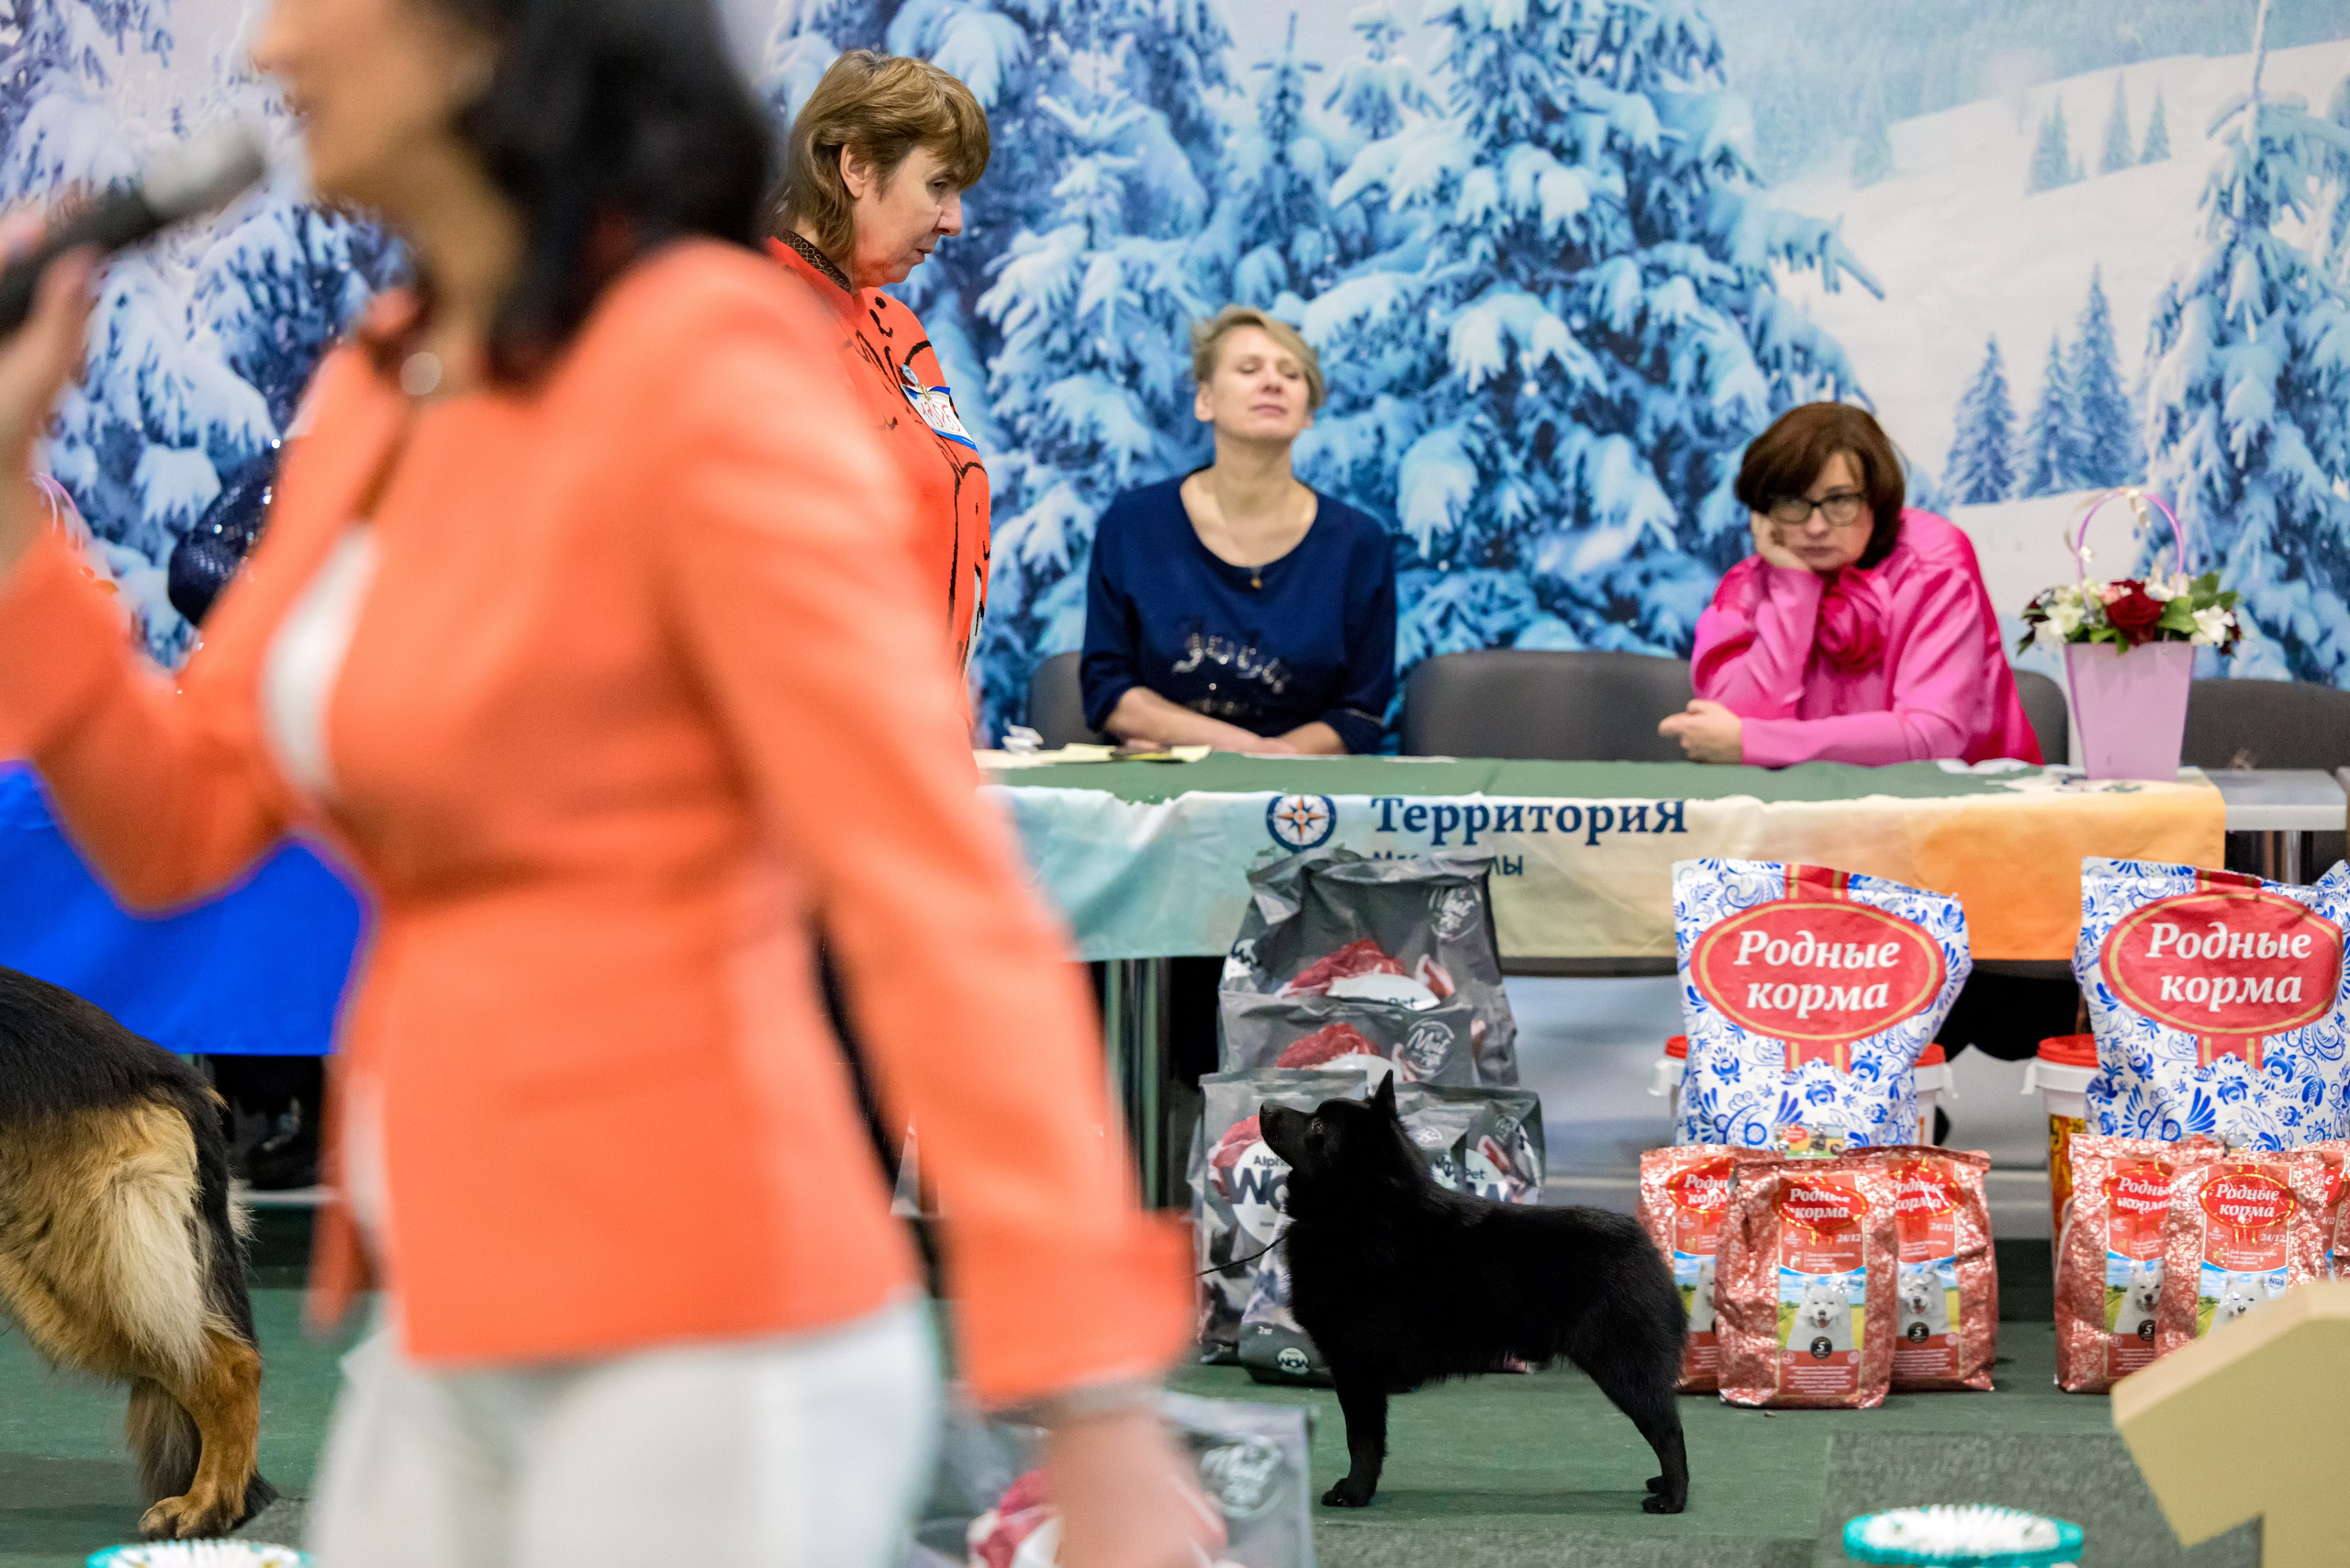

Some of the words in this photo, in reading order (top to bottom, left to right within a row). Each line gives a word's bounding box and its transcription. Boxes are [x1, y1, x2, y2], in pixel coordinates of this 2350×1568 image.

[1371, 797, 1687, 846] ТерриториЯ
[2144, 921, 2311, 960] Родные
[1733, 929, 1901, 969] Родные
[1746, 982, 1889, 1019] корма
[2160, 974, 2301, 1013] корма
[1253, 1155, 1288, 1169] Alph
[1684, 1173, 1728, 1190] Родн
[2117, 1176, 2170, 1196] Родны
[1789, 1187, 1851, 1203] Родные
[2215, 1183, 2280, 1201] Родные
[1687, 1193, 1728, 1208] корм
[1794, 1206, 1849, 1221] корма
[2219, 1204, 2275, 1220] корма
[2259, 1233, 2287, 1242] 24/12
[1914, 1327, 1923, 1337] 5
[2143, 1324, 2153, 1334] 5
[1816, 1341, 1826, 1352] 5
